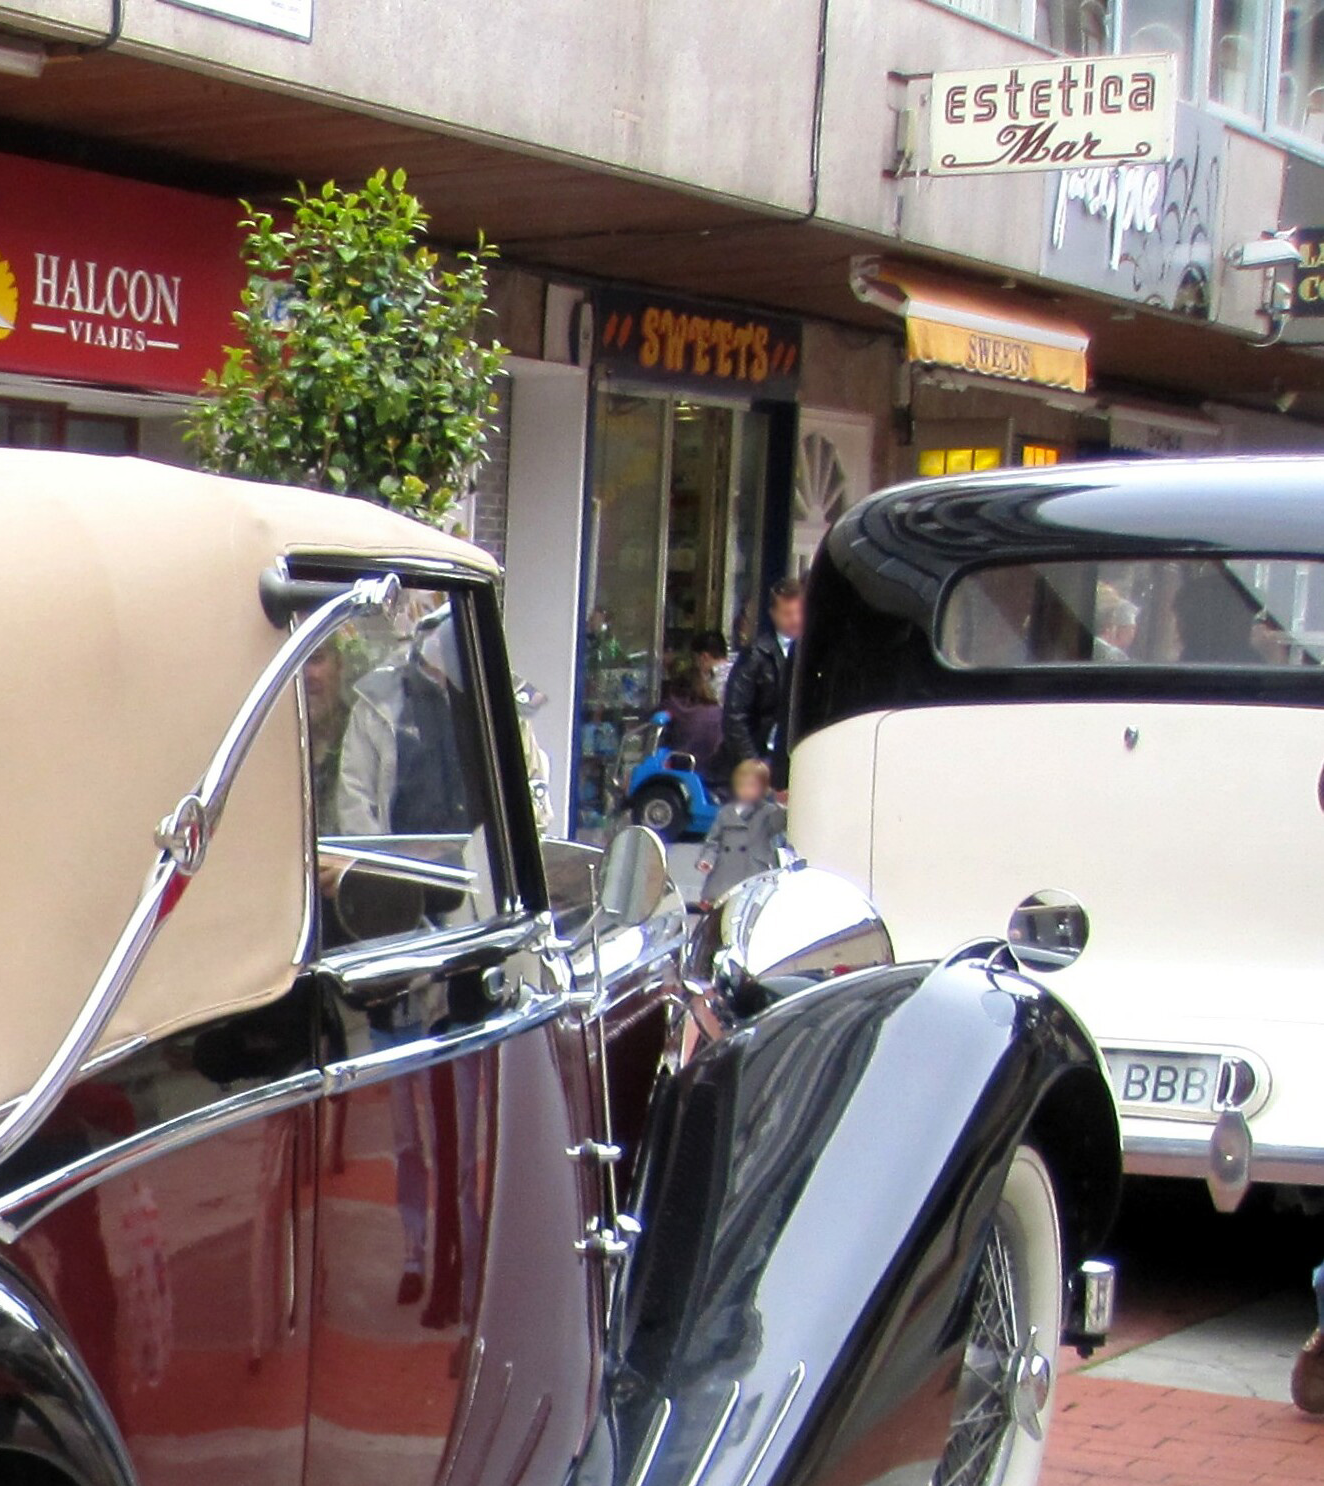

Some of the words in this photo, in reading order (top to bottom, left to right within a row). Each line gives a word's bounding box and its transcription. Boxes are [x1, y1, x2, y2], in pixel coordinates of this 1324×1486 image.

[996, 121, 1103, 166] Mar
[33, 252, 182, 327] HALCON
[69, 319, 146, 352] VIAJES
[640, 307, 770, 382] SWEETS
[968, 334, 1031, 376] SWEETS
[1122, 1063, 1210, 1105] BBB
